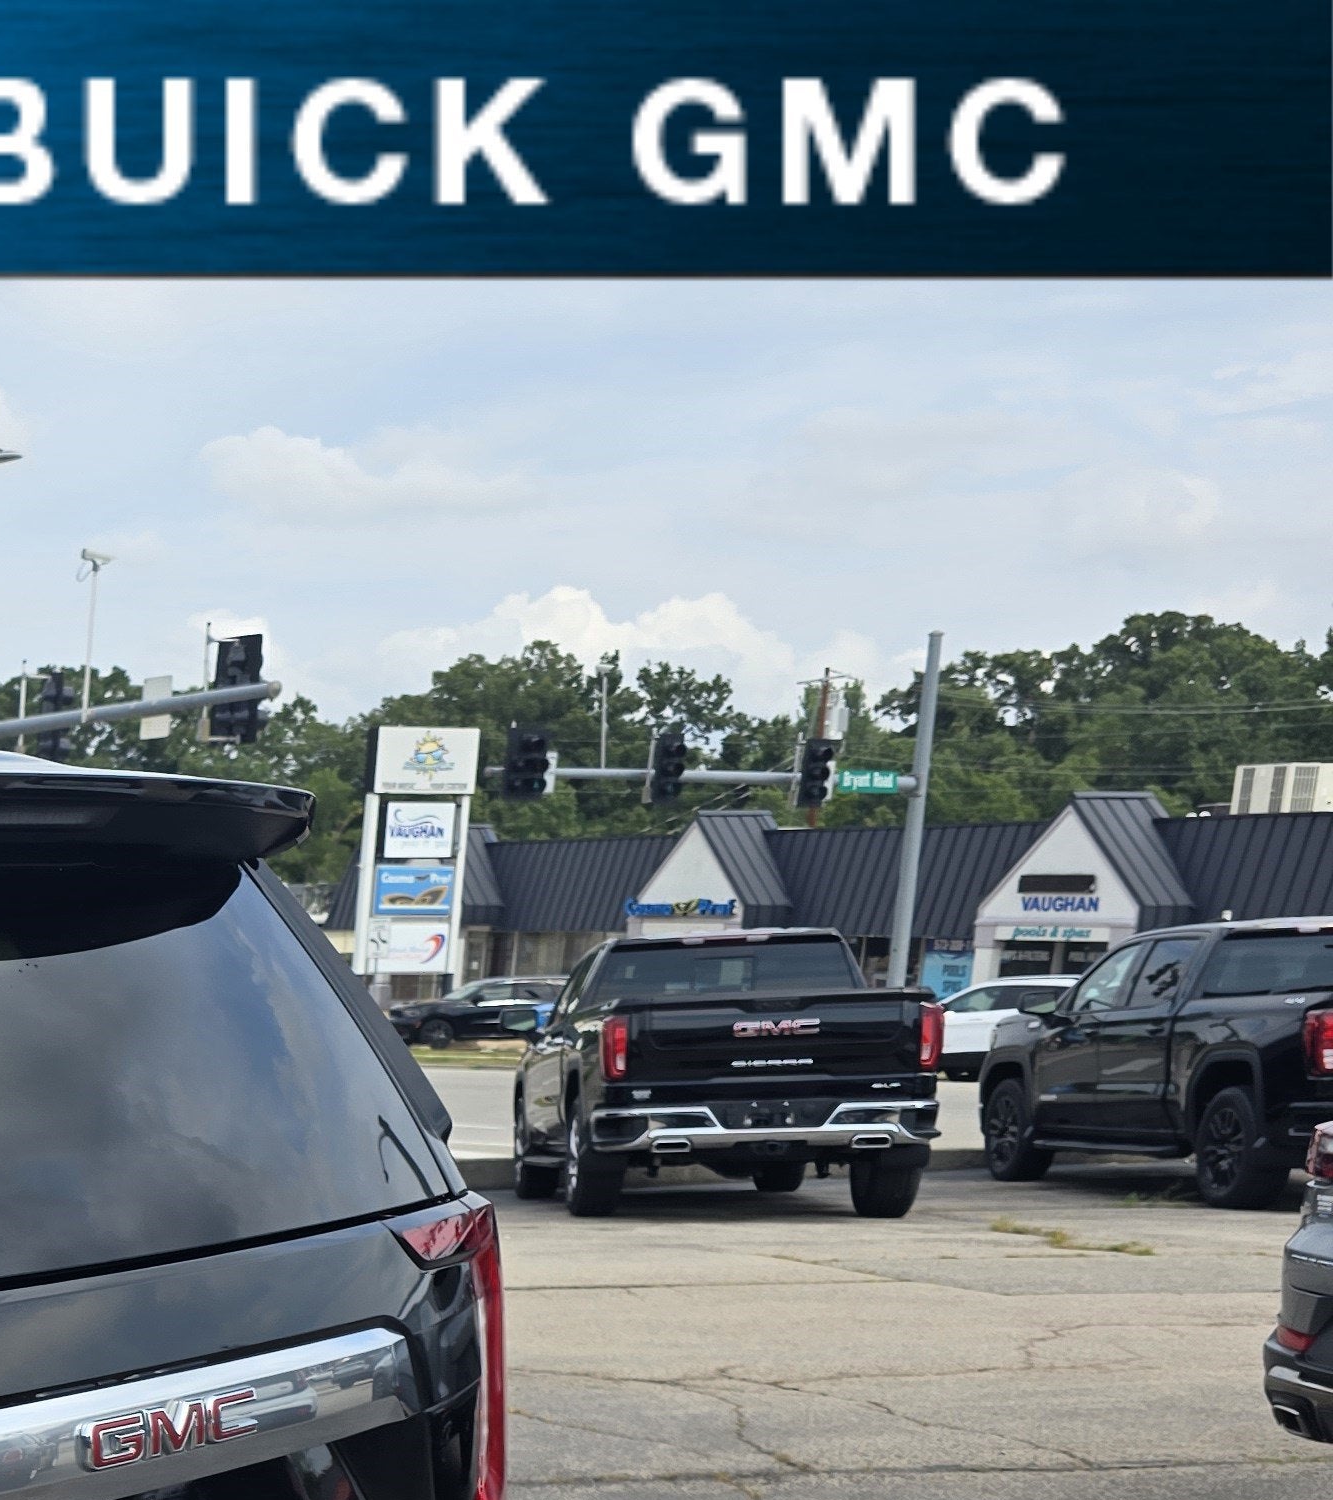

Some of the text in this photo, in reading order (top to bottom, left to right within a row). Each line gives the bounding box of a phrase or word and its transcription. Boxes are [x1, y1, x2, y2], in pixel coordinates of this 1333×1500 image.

[389, 825, 445, 838] VAUGHAN
[1021, 895, 1100, 912] VAUGHAN
[1012, 926, 1048, 939] pools
[733, 1018, 821, 1038] GMC
[77, 1387, 259, 1471] GMC
